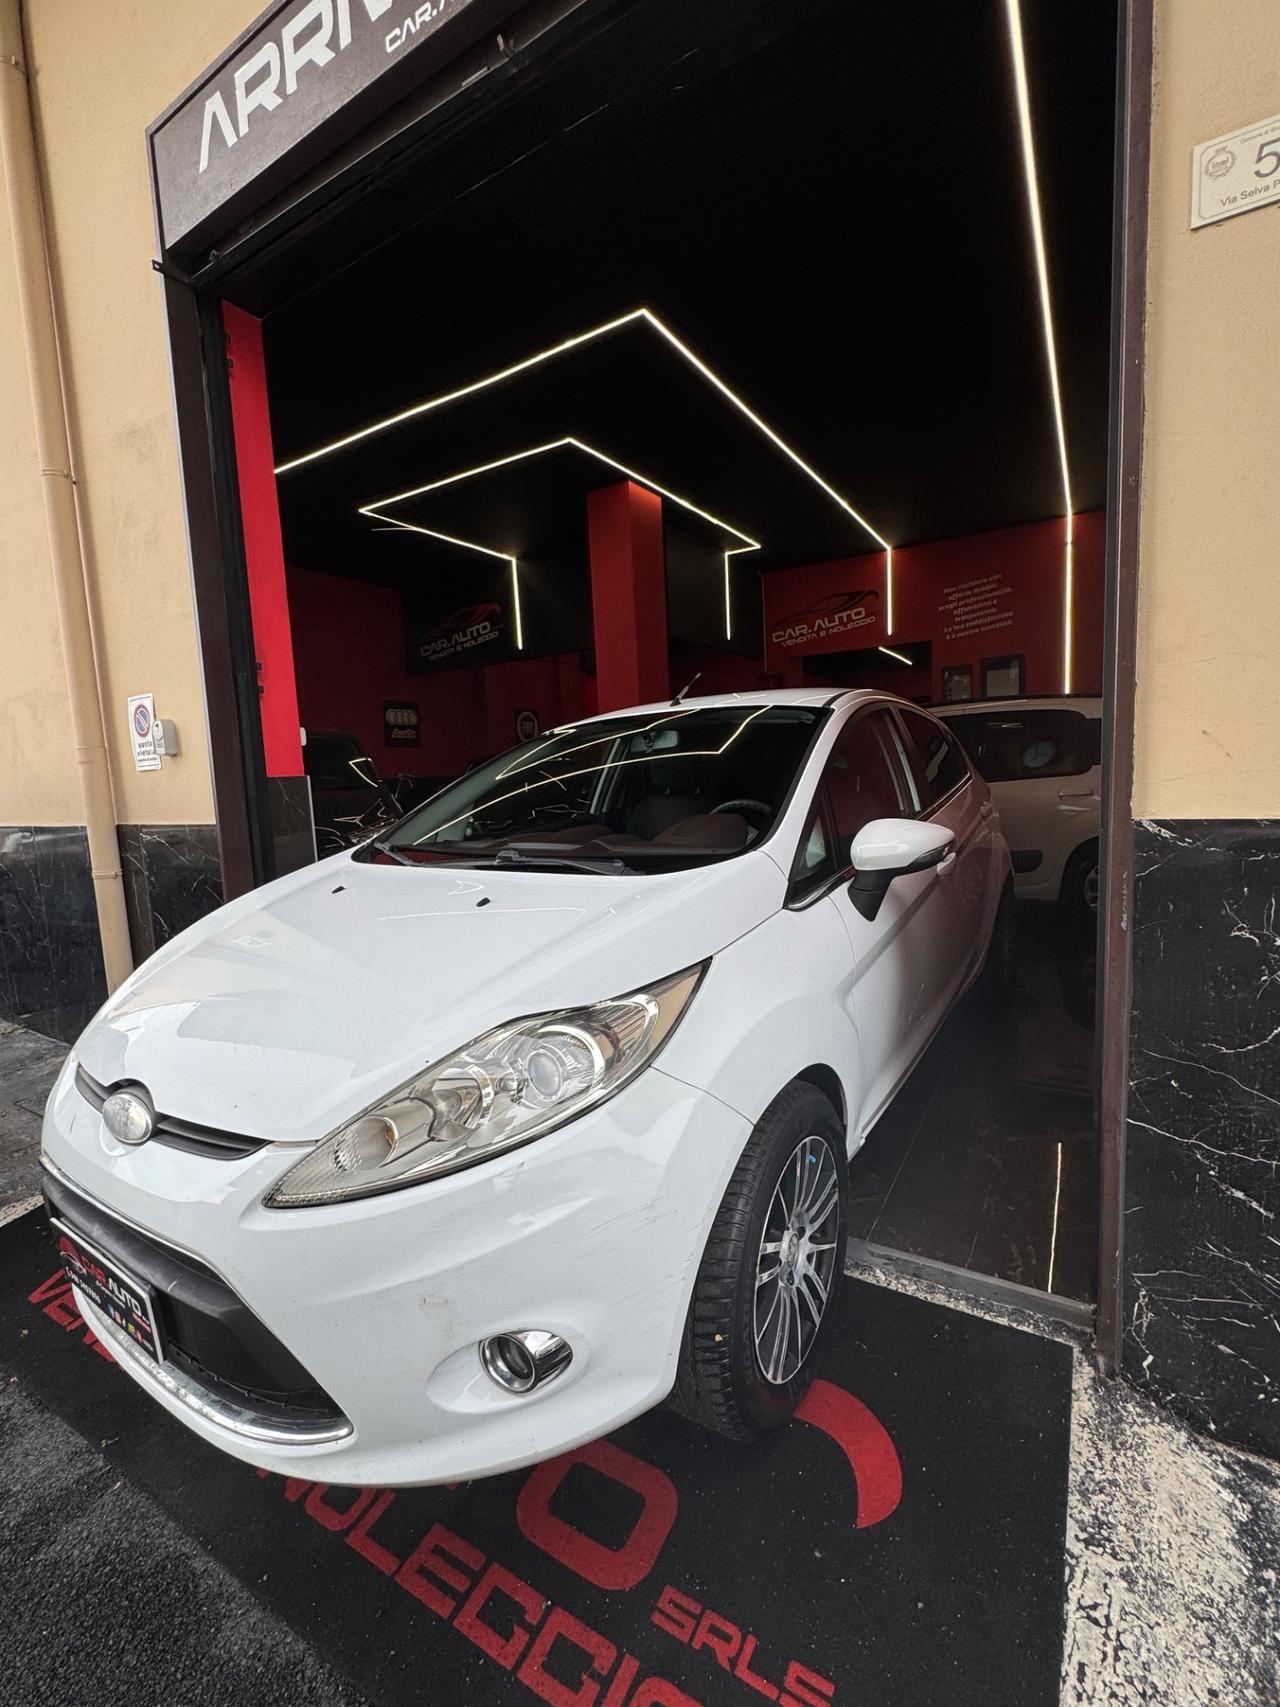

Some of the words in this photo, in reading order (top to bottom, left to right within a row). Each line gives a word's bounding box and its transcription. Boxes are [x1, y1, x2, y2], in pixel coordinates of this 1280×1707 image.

[1220, 195, 1238, 206] Via
[1240, 184, 1270, 200] Selva
[420, 621, 491, 656] CAR.AUTO
[772, 607, 866, 642] CAR.AUTO
[782, 633, 818, 648] VENDITA
[829, 616, 876, 635] NOLEGGIO
[651, 1584, 836, 1707] SRLS
